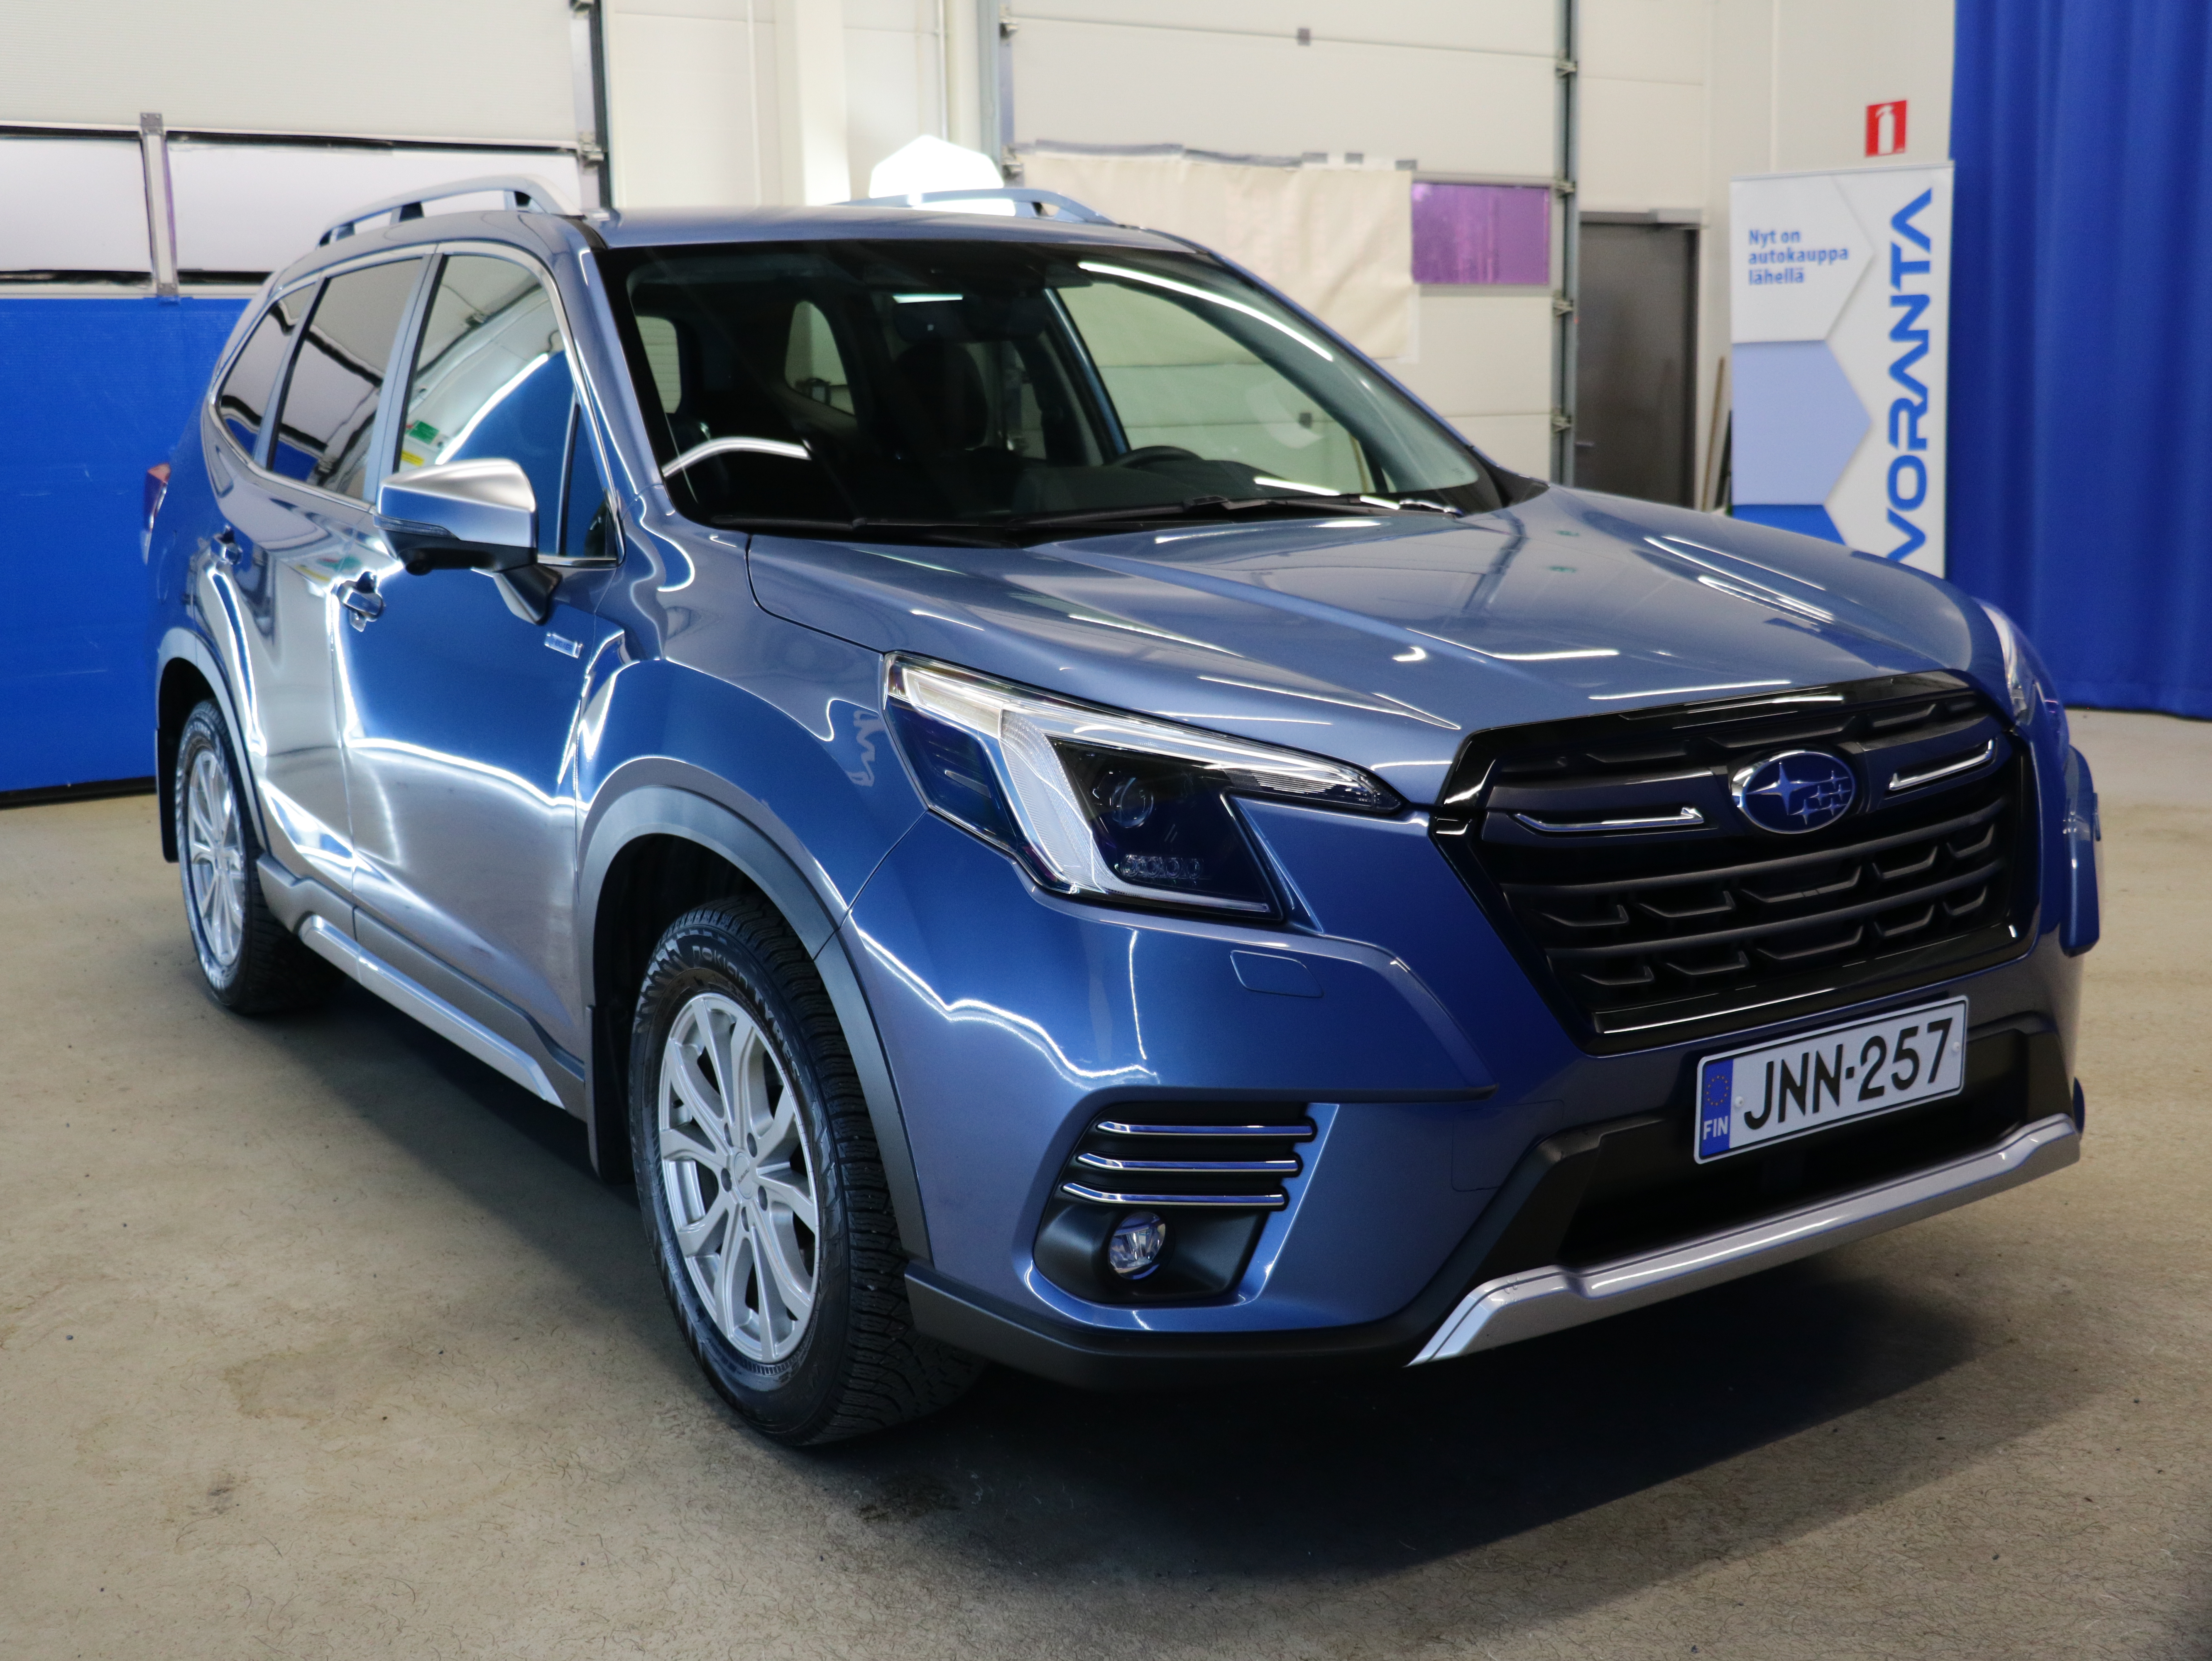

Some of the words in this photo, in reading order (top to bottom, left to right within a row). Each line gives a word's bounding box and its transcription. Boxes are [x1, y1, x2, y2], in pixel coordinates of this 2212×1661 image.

[1749, 229, 1776, 248] Nyt
[1781, 231, 1800, 243] on
[1749, 247, 1849, 266] autokauppa
[1749, 267, 1805, 285] lähellä
[935, 696, 975, 715] FORESTER
[1744, 1017, 1953, 1130] JNN-257
[1703, 1115, 1728, 1140] FIN
